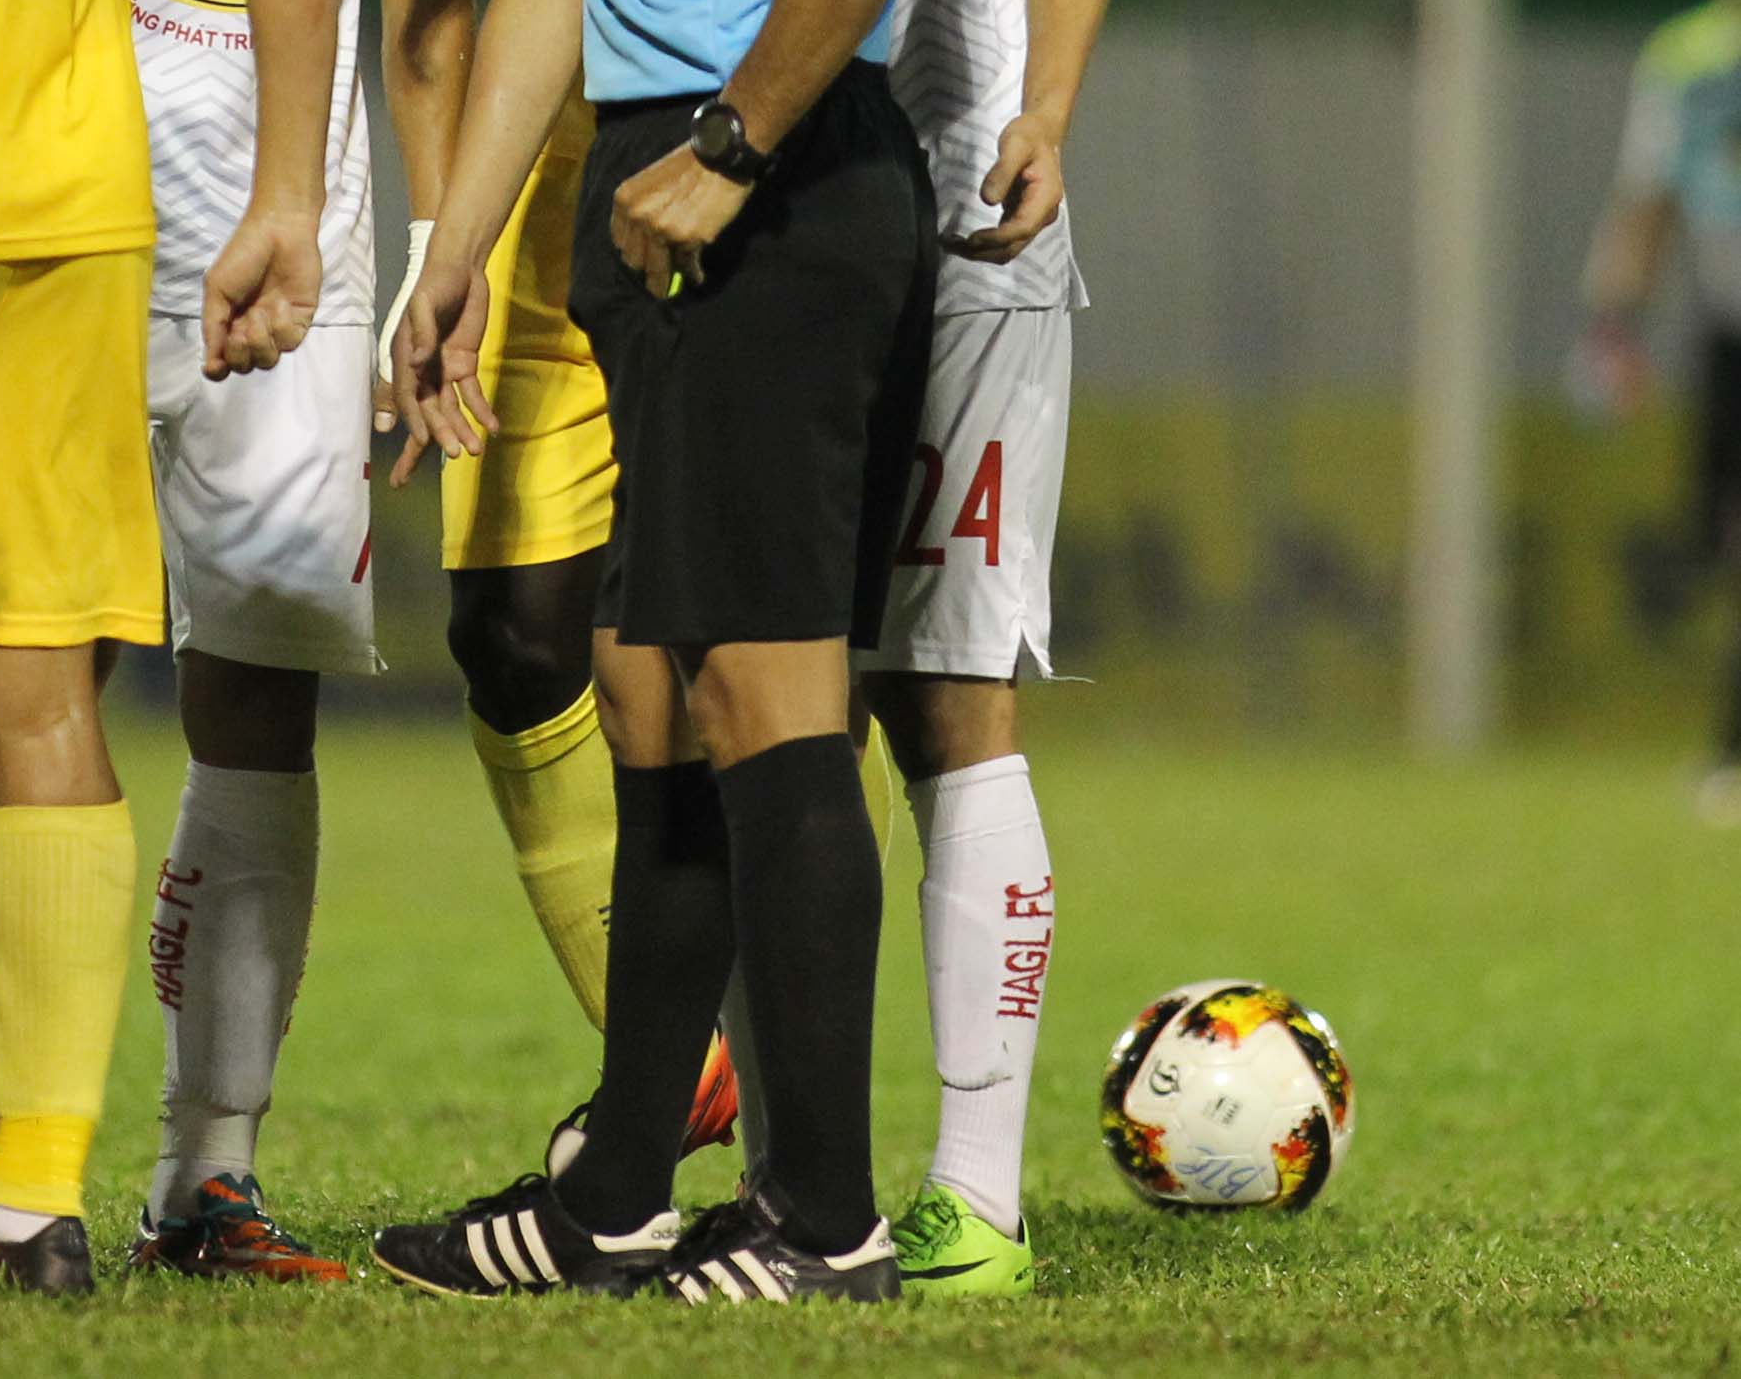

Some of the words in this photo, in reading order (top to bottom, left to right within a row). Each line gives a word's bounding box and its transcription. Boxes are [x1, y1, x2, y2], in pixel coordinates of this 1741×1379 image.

[894, 440, 1003, 567] 24
[1004, 875, 1054, 918] FC
[147, 918, 190, 1013] HAGL
[996, 927, 1052, 1020] HAGL
